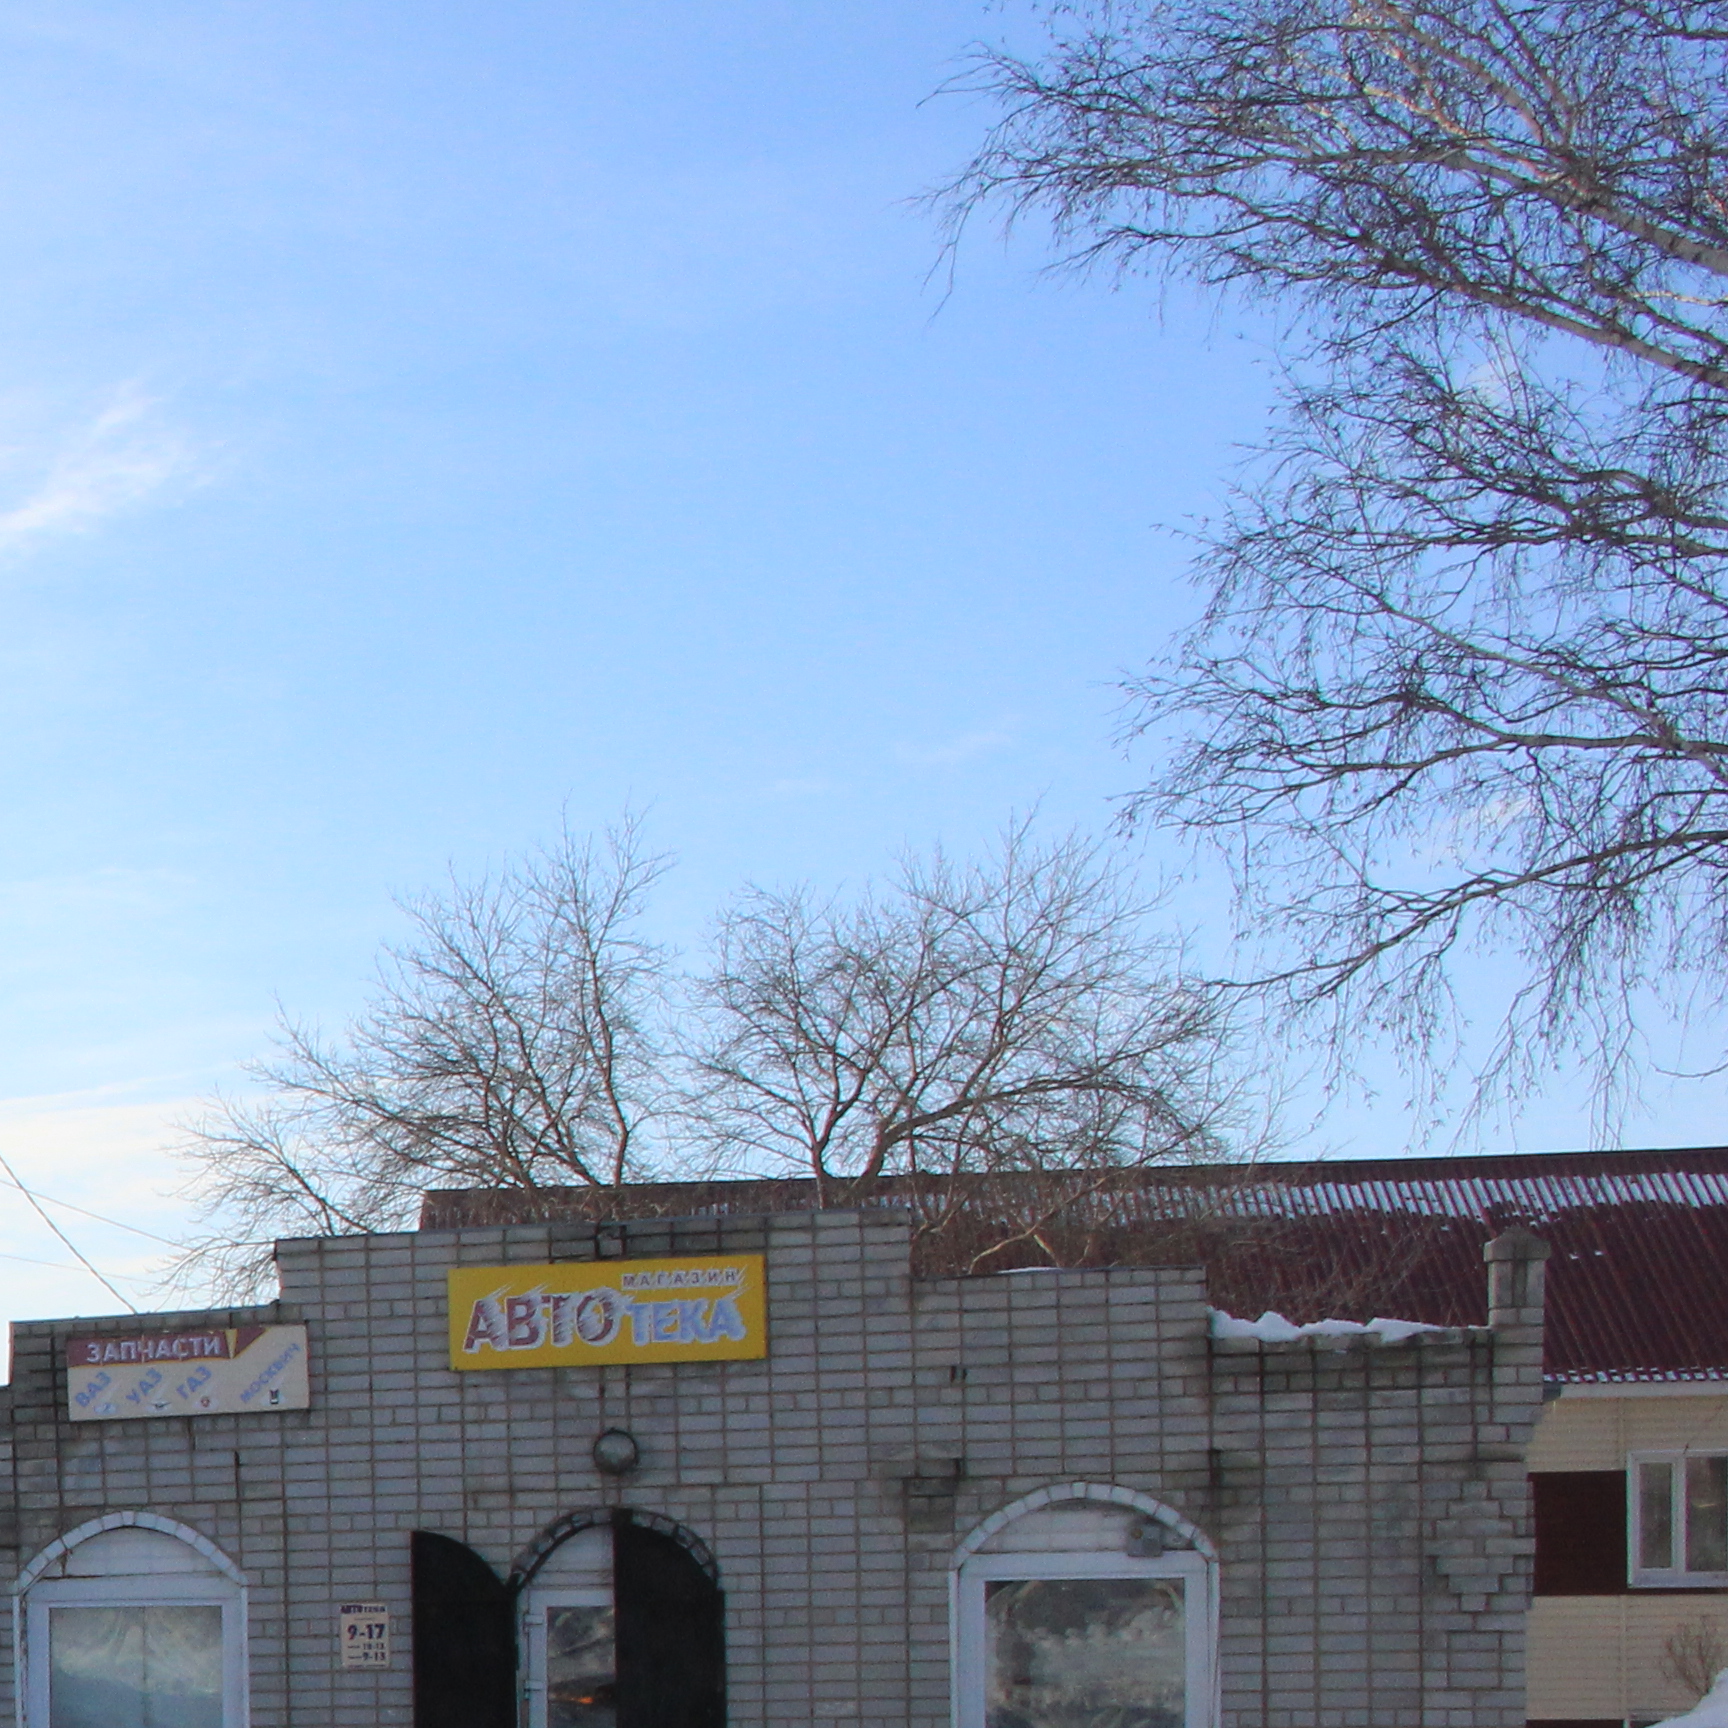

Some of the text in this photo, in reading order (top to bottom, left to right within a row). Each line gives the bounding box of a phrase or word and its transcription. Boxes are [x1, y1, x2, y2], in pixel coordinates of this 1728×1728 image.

[622, 1268, 739, 1288] МАГАЗИН
[86, 1336, 221, 1363] ЗАПЧАСТИ
[75, 1343, 301, 1408] ВАЗ УАЗ ГАЗ МОСКВИЧ
[347, 1624, 386, 1640] 9-17
